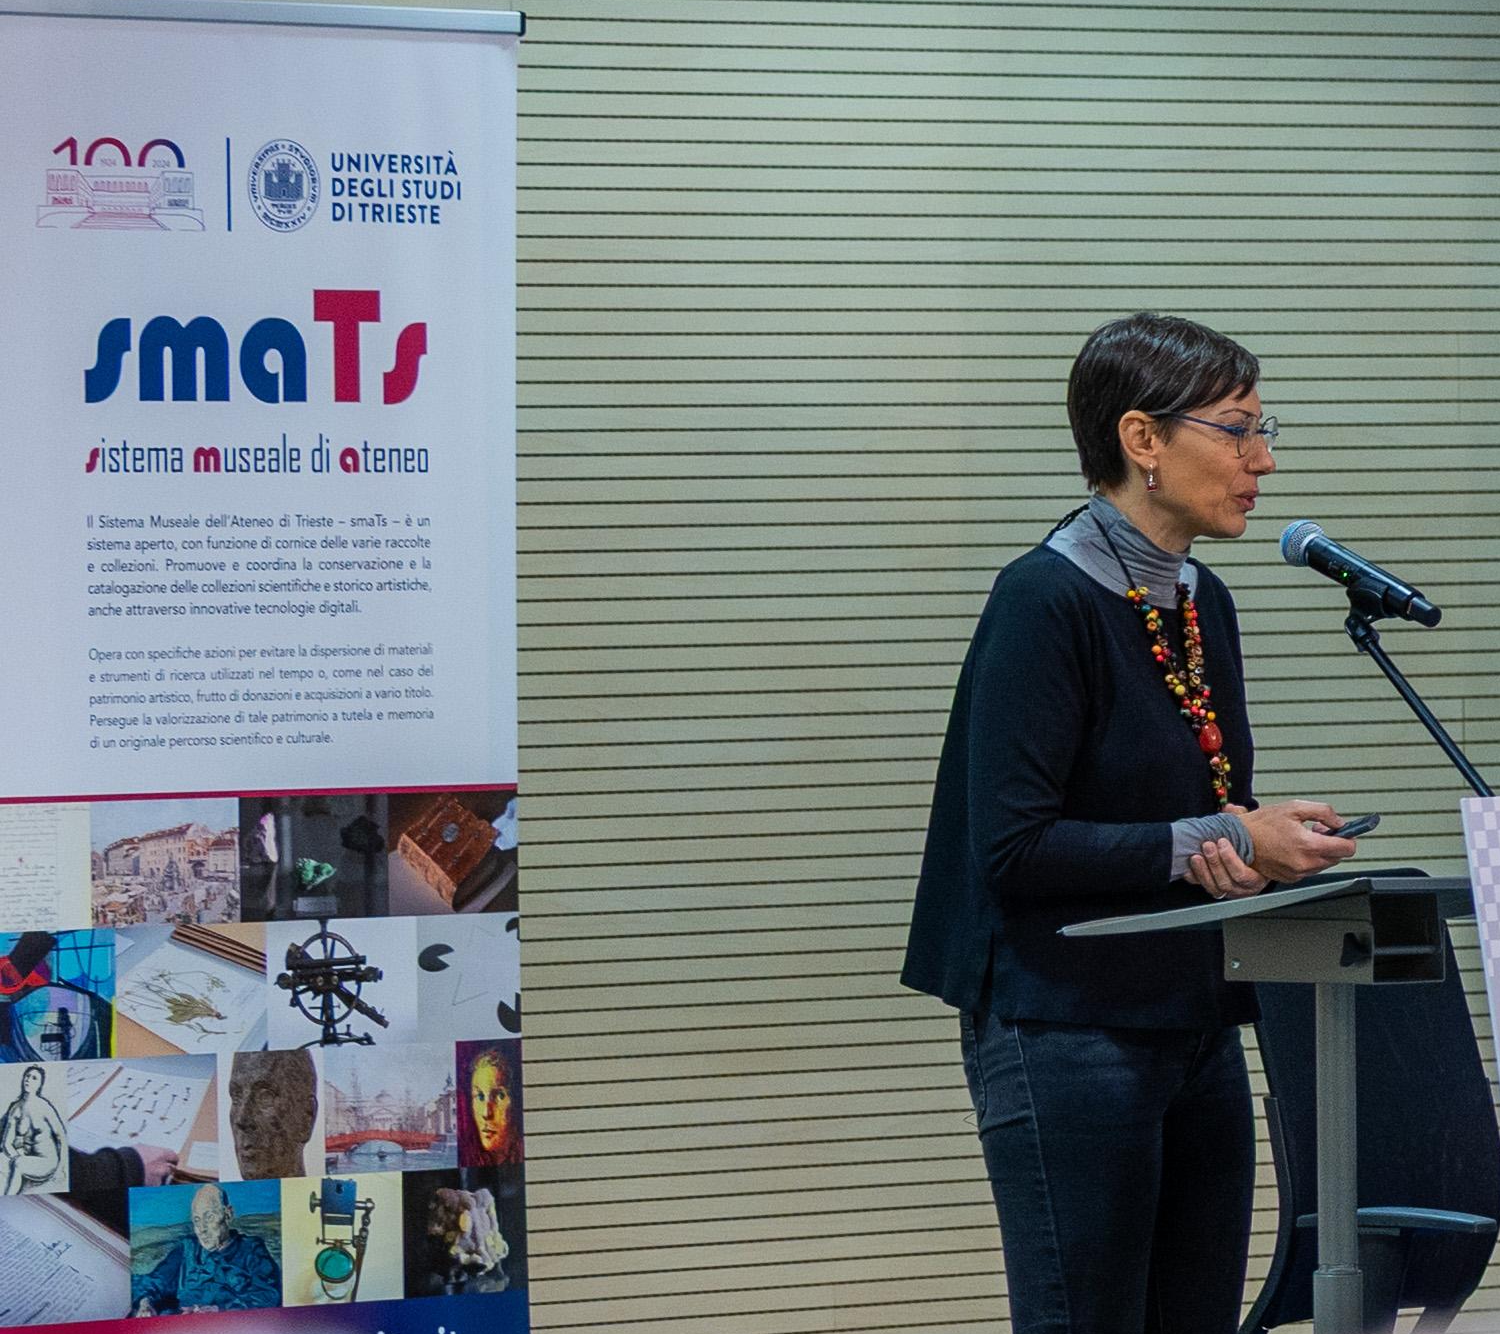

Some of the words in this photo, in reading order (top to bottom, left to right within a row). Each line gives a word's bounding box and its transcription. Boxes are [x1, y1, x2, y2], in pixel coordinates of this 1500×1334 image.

[330, 149, 459, 177] UNIVERSITÀ
[330, 177, 396, 201] DEGLI
[402, 178, 462, 202] STUDI
[331, 200, 353, 223] DI
[356, 200, 441, 226] TRIESTE
[83, 288, 428, 405] smaTs
[84, 432, 184, 475] sistema
[192, 432, 301, 475] museale
[310, 432, 331, 474] di
[338, 439, 430, 474] ateneo
[87, 515, 93, 528] Il
[98, 514, 144, 529] Sistema
[150, 514, 200, 528] Museale
[205, 514, 274, 528] dell'Ateneo
[279, 514, 290, 528] di
[295, 514, 334, 527] Trieste
[350, 513, 387, 527] smaTs
[405, 514, 412, 527] è
[417, 516, 430, 527] un
[87, 538, 131, 551] sistema
[134, 538, 178, 554] aperto,
[181, 539, 203, 550] con
[206, 535, 257, 550] funzione
[261, 535, 272, 549] di
[275, 535, 317, 549] cornice
[320, 535, 348, 549] delle
[351, 535, 381, 549] varie
[385, 534, 431, 549] raccolte
[87, 561, 95, 573] e
[101, 559, 159, 573] collezioni.
[165, 558, 226, 572] Promuove
[232, 560, 239, 571] e
[246, 557, 296, 571] coordina
[303, 556, 312, 570] la
[318, 557, 404, 570] conservazione
[409, 559, 416, 569] e
[422, 556, 431, 570] la
[88, 580, 167, 598] catalogazione
[170, 580, 198, 594] delle
[201, 579, 256, 593] collezioni
[258, 578, 321, 593] scientifiche
[323, 581, 331, 592] e
[333, 579, 373, 592] storico
[376, 578, 432, 593] artistiche,
[88, 603, 122, 616] anche
[125, 603, 186, 616] attraverso
[189, 601, 251, 615] innovative
[255, 600, 315, 617] tecnologie
[318, 600, 362, 617] digitali.
[90, 735, 100, 749] di
[103, 737, 116, 748] un
[119, 734, 166, 751] originale
[169, 735, 217, 749] percorso
[219, 732, 274, 746] scientifico
[276, 734, 283, 744] e
[286, 730, 334, 744] culturale.
